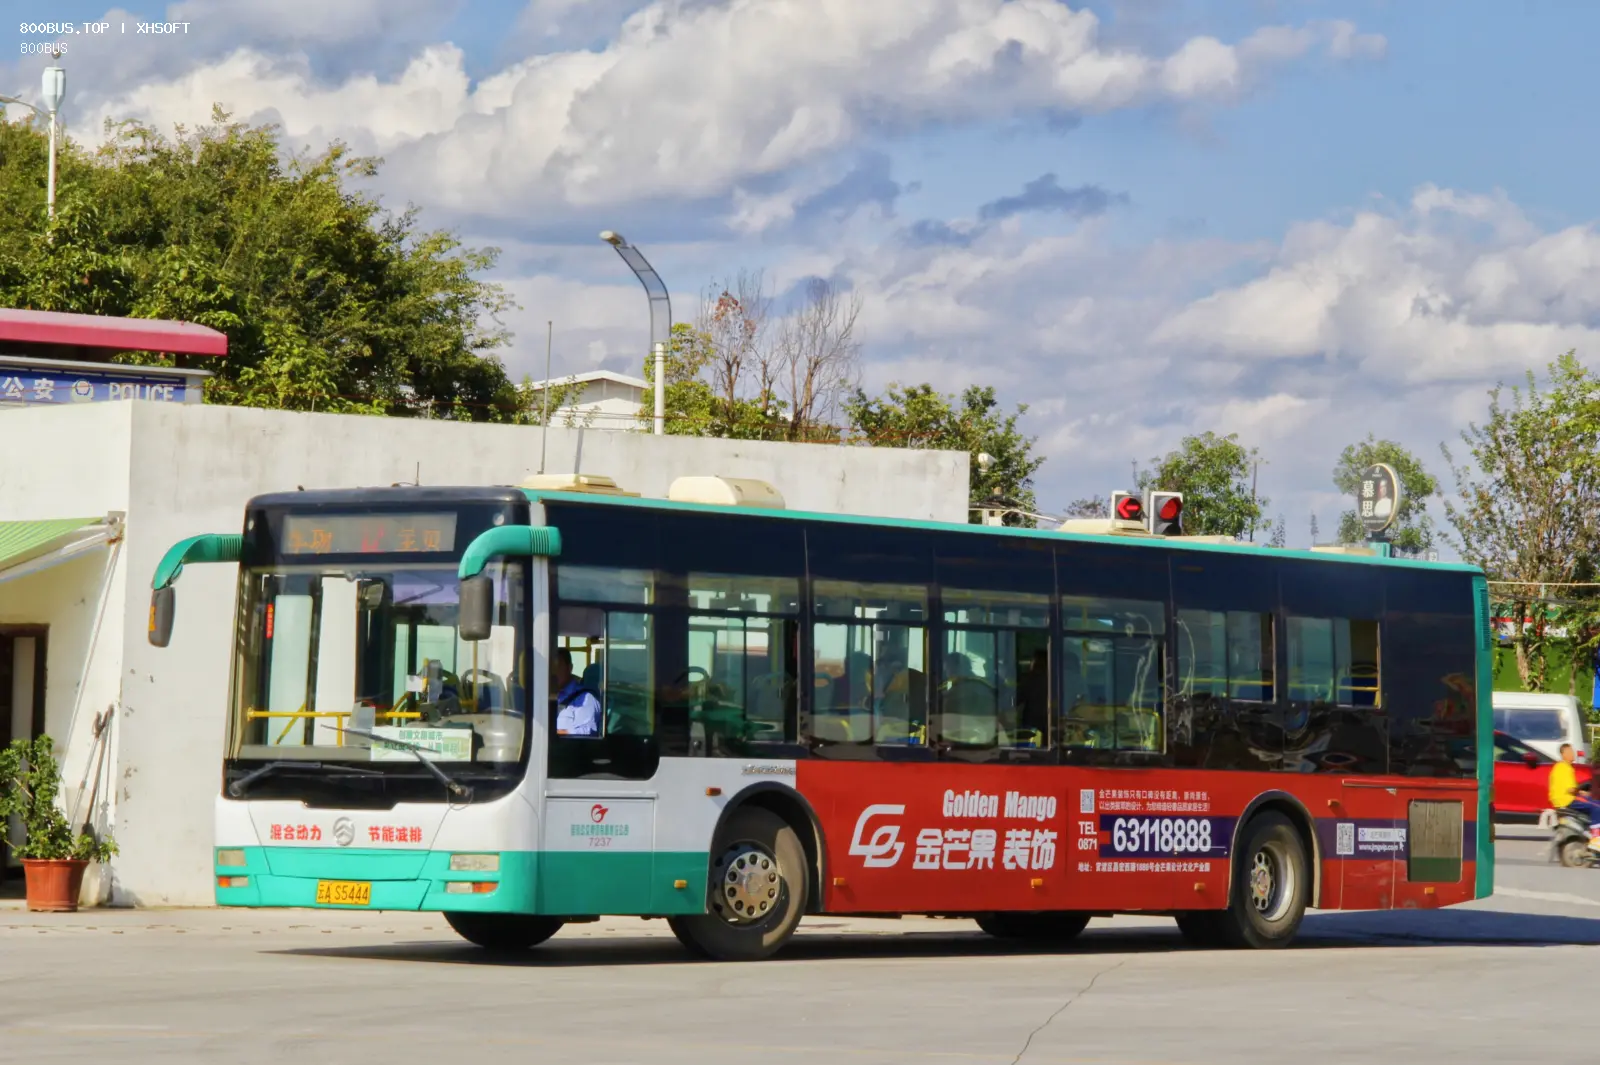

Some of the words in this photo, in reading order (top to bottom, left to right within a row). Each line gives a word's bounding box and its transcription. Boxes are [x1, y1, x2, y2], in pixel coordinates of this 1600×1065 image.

[2, 376, 55, 400] 公安
[109, 382, 174, 401] POLICE
[943, 789, 999, 818] Golden
[1004, 791, 1057, 822] Mango
[270, 824, 322, 841] 混合动力
[368, 826, 423, 843] 节能减排
[1078, 821, 1097, 835] TEL
[1113, 817, 1212, 852] 63118888
[589, 837, 612, 847] 7237
[1078, 838, 1098, 850] 0871
